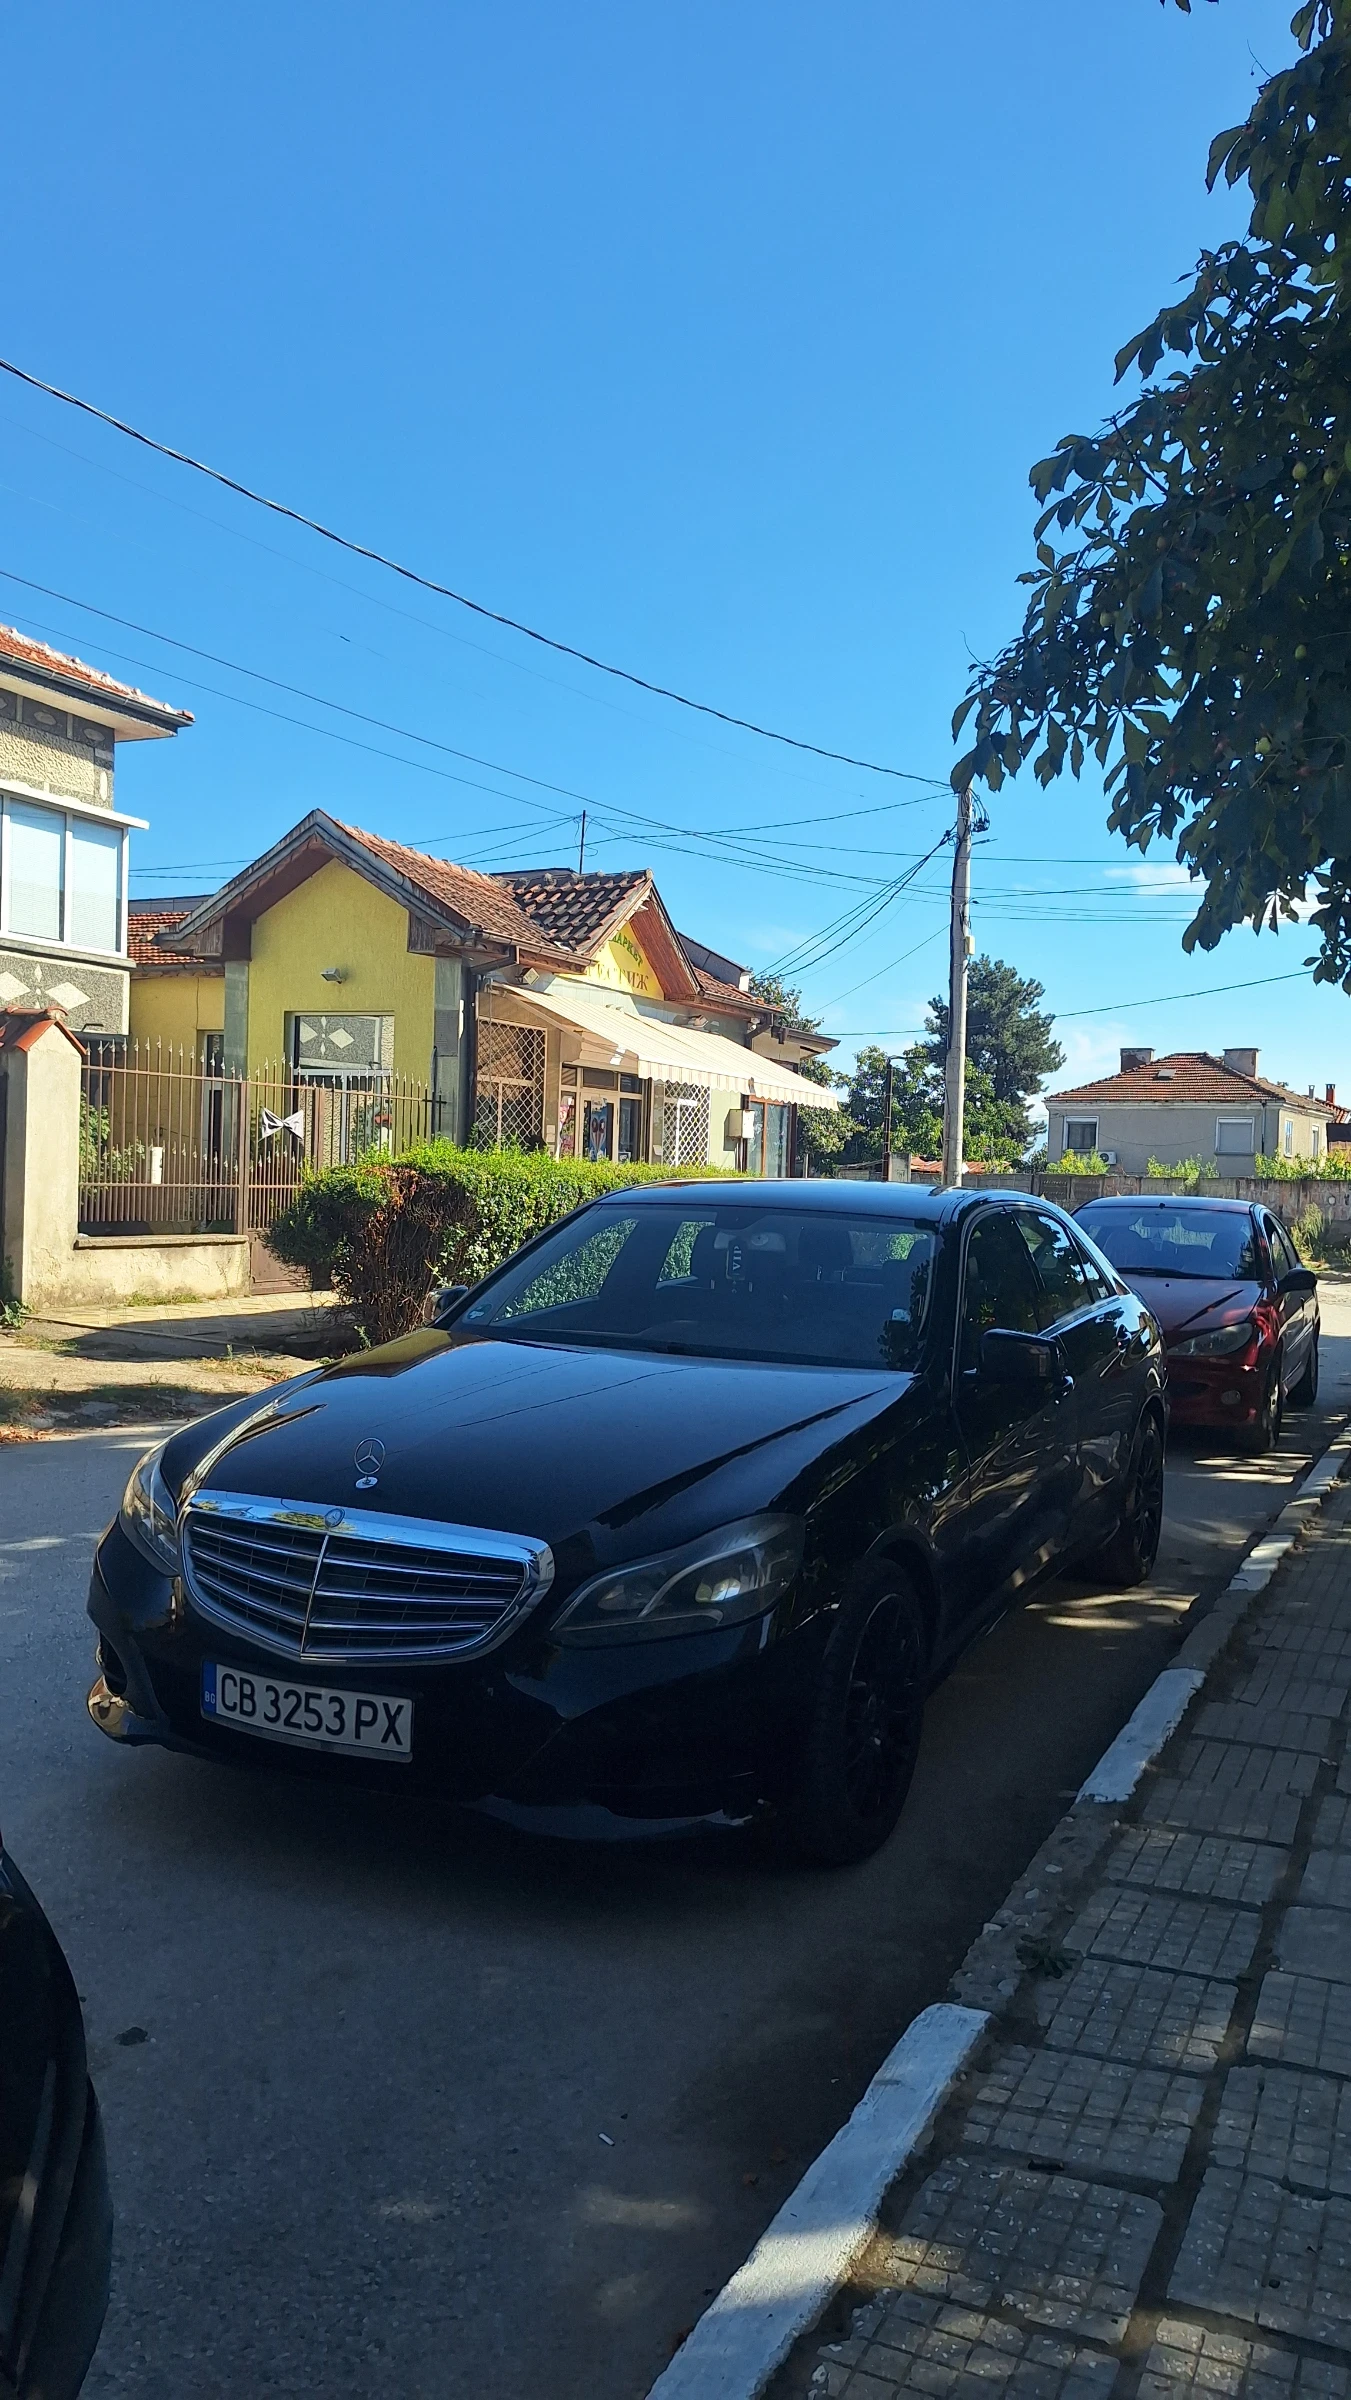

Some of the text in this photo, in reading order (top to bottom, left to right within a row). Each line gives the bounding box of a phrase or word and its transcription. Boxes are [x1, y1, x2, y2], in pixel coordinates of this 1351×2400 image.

[732, 1245, 742, 1271] VIP
[205, 1690, 216, 1705] BG
[221, 1673, 404, 1746] CB 3253 PX
